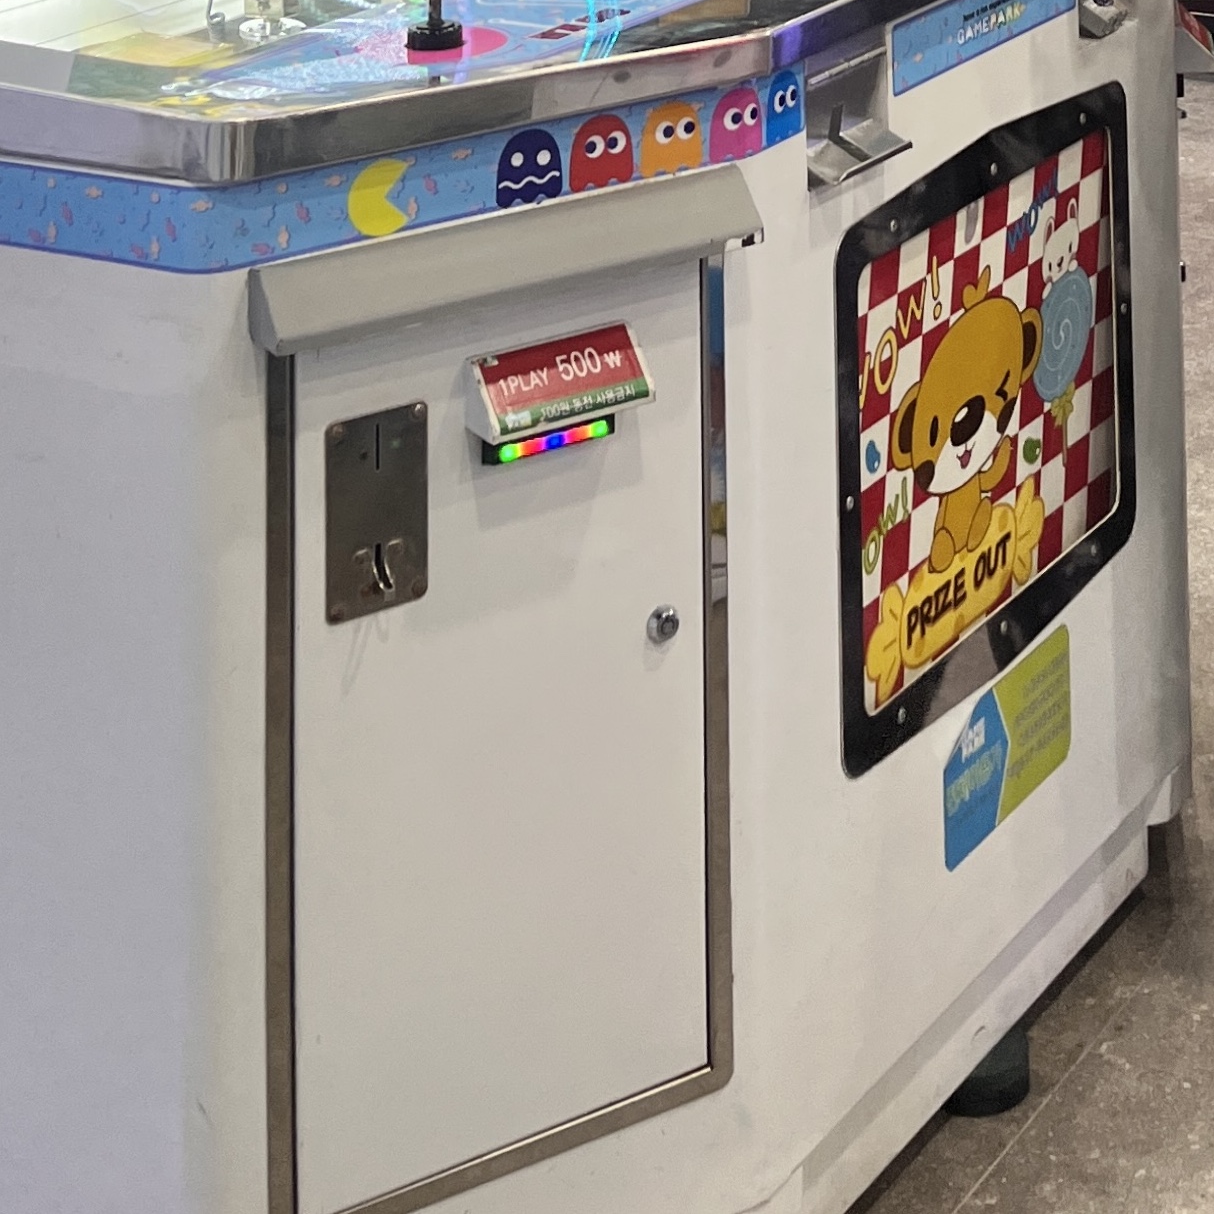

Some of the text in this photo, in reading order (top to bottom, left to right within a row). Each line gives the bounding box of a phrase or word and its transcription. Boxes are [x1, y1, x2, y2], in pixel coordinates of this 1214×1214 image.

[957, 1, 1024, 46] GAMEPARK
[498, 366, 549, 397] 1PLAY
[555, 346, 600, 382] 500
[906, 531, 1012, 650] PRIZE OUT
